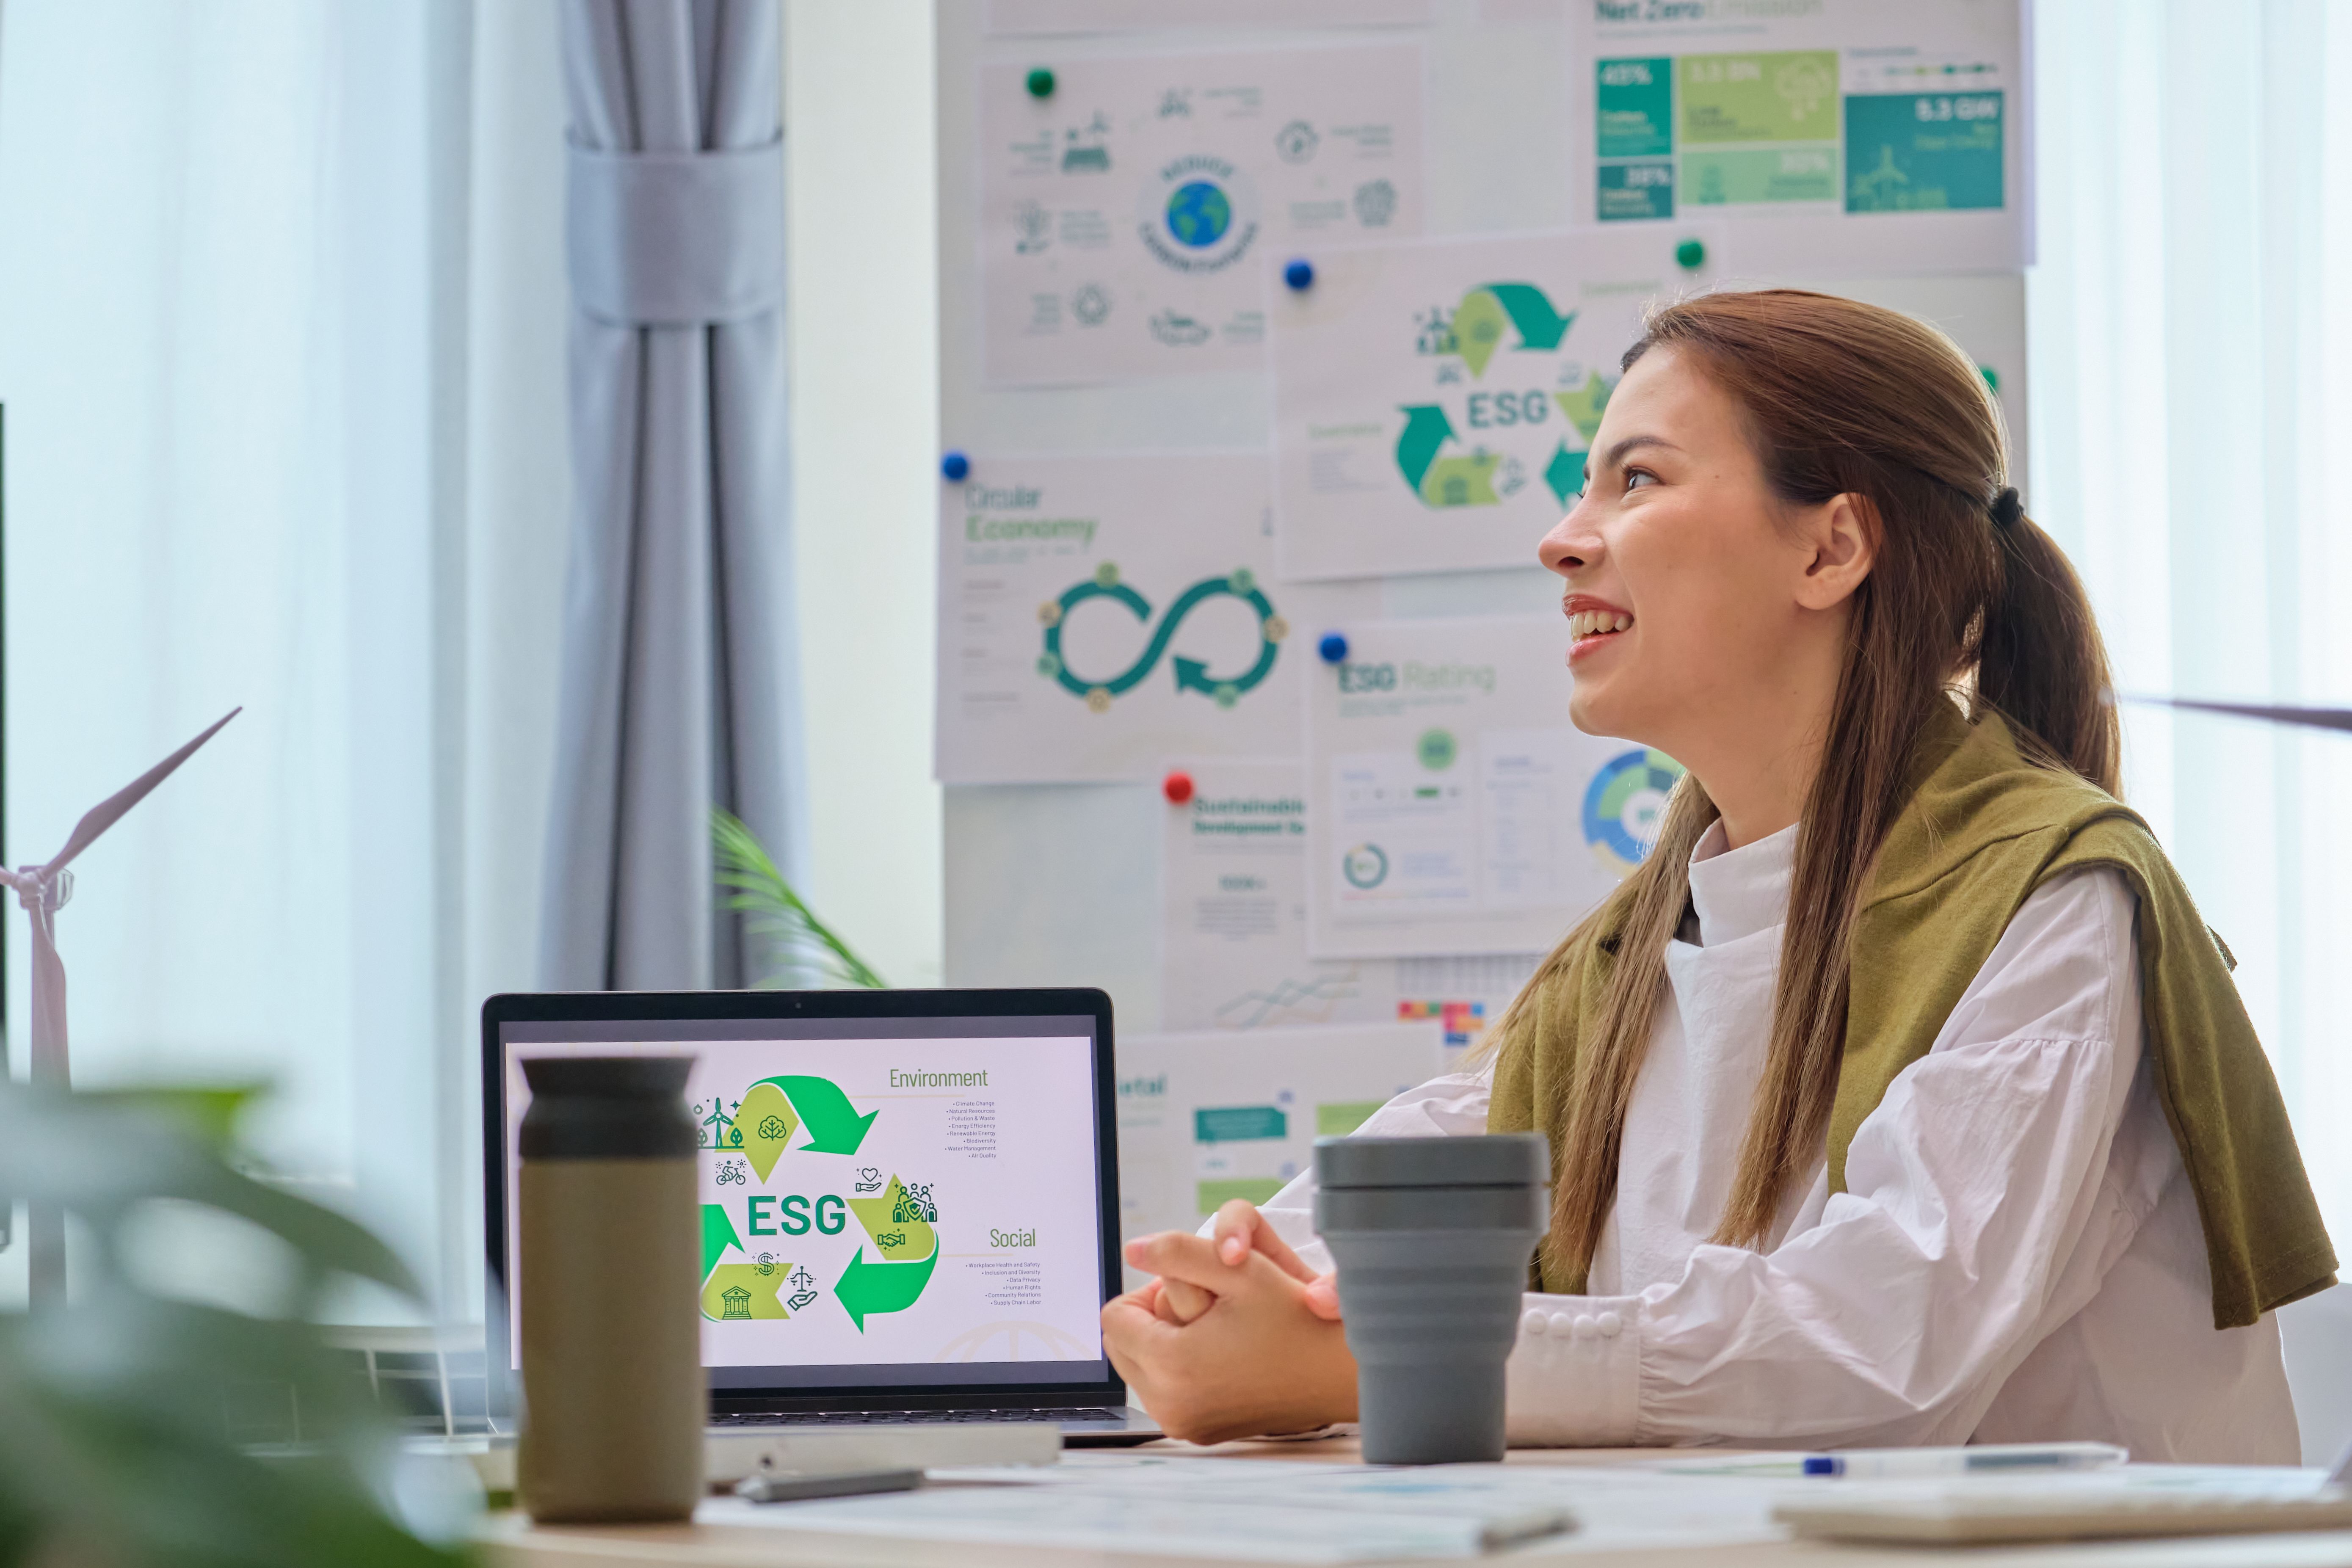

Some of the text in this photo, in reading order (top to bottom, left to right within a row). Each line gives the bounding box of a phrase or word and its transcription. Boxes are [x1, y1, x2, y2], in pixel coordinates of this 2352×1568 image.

[1468, 391, 1549, 429] ESG
[965, 483, 1042, 510] Circular
[966, 515, 1099, 551] Economy
[1338, 661, 1496, 696] ESG Rating
[890, 1069, 988, 1087] Environment
[748, 1195, 845, 1236] ESG
[990, 1228, 1035, 1247] Social
